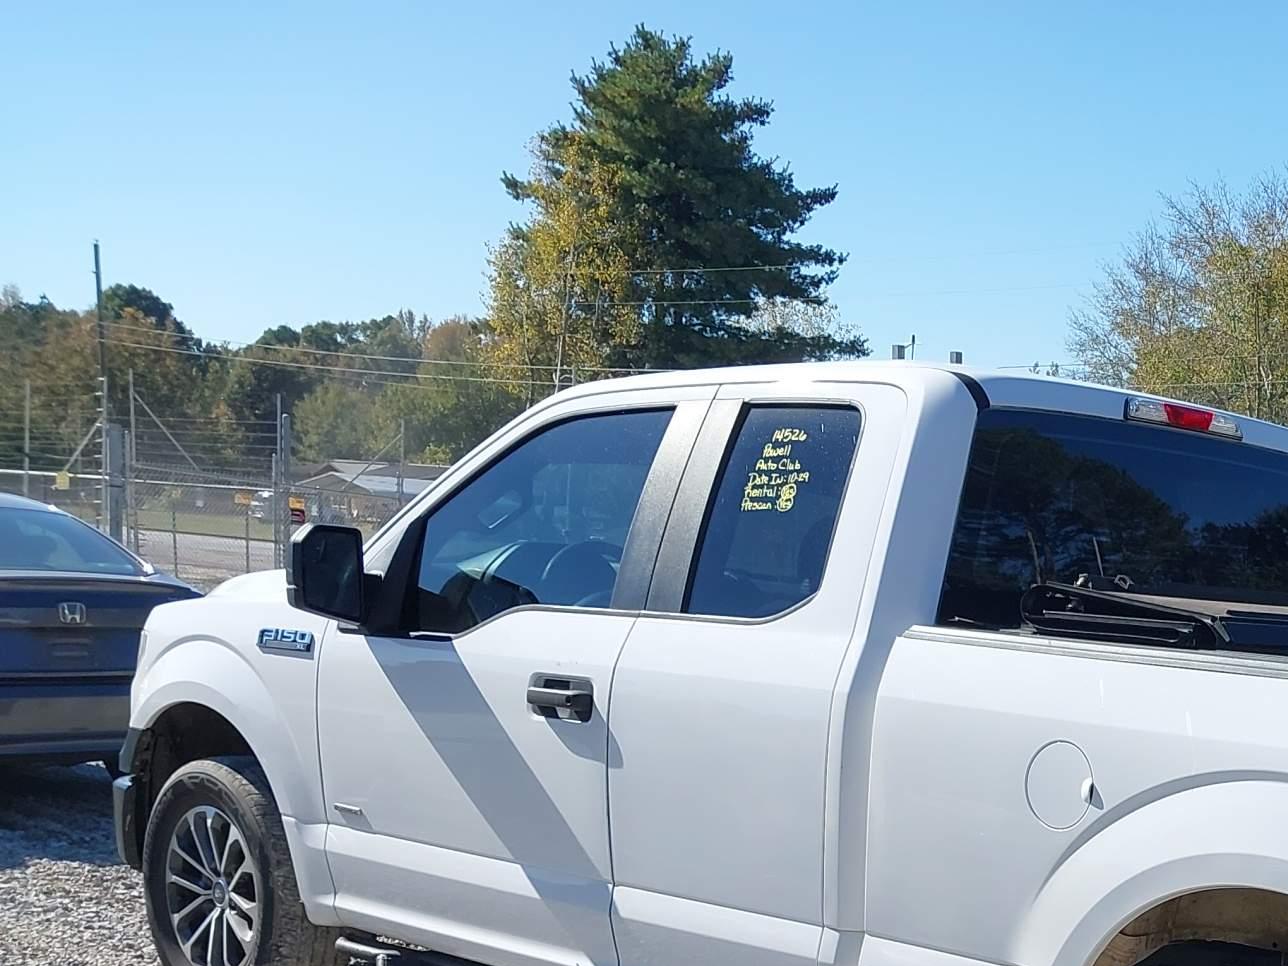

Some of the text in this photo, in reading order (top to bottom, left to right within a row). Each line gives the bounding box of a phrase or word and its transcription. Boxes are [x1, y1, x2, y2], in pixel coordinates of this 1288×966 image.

[772, 428, 807, 443] 14526
[762, 443, 792, 458] Powell
[755, 458, 801, 472] Auto Club
[747, 472, 769, 487] Date
